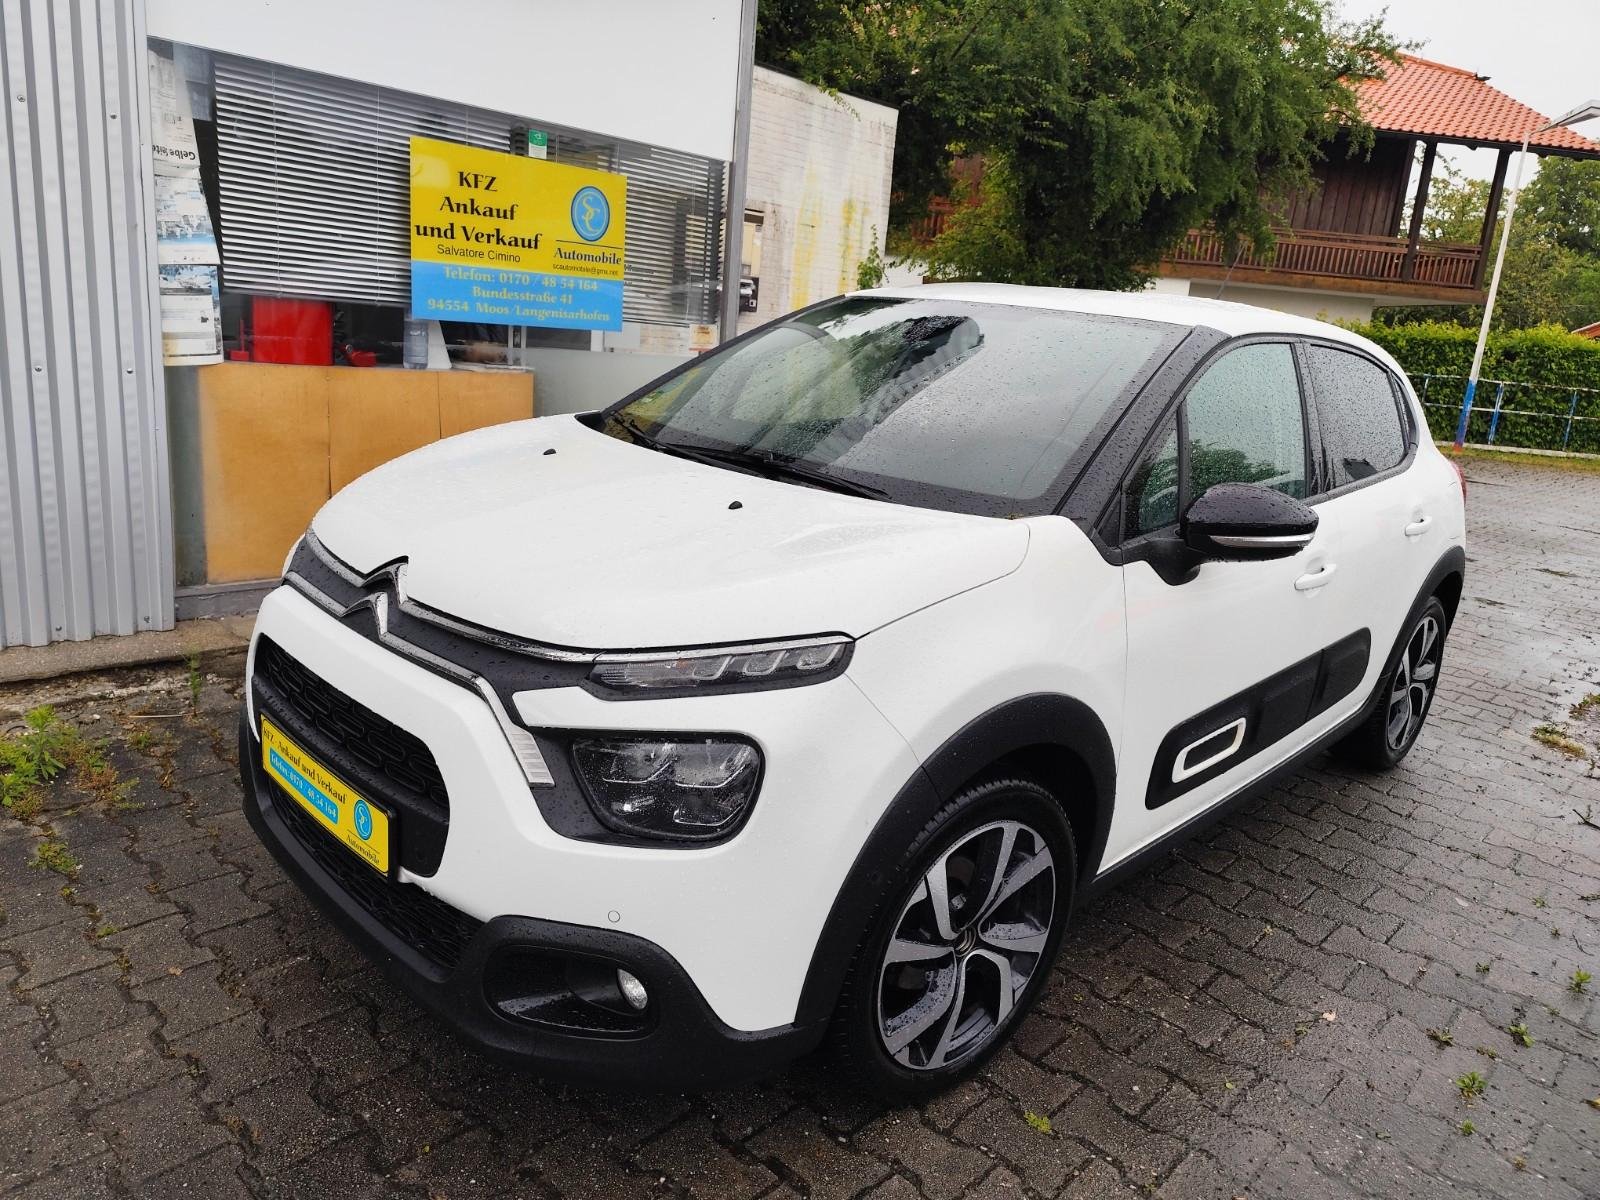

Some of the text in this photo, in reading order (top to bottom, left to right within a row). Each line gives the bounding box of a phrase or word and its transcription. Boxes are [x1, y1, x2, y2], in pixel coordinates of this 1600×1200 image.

[458, 171, 498, 192] KFZ
[440, 196, 519, 221] Ankauf
[414, 222, 542, 250] und Verkauf
[437, 244, 521, 263] Salvatore Cimino
[553, 247, 622, 265] Automobile
[443, 266, 495, 283] Telefon:
[499, 272, 530, 286] 0170
[541, 276, 557, 288] 48
[561, 278, 575, 290] 54
[578, 279, 598, 292] 164
[427, 298, 469, 312] 94554
[475, 302, 509, 315] Moos
[472, 286, 573, 305] Bundesstraße 41
[278, 740, 301, 767] Ankauf
[302, 763, 316, 780] und
[316, 773, 347, 804] Verkauf
[346, 834, 380, 864] Automobile
